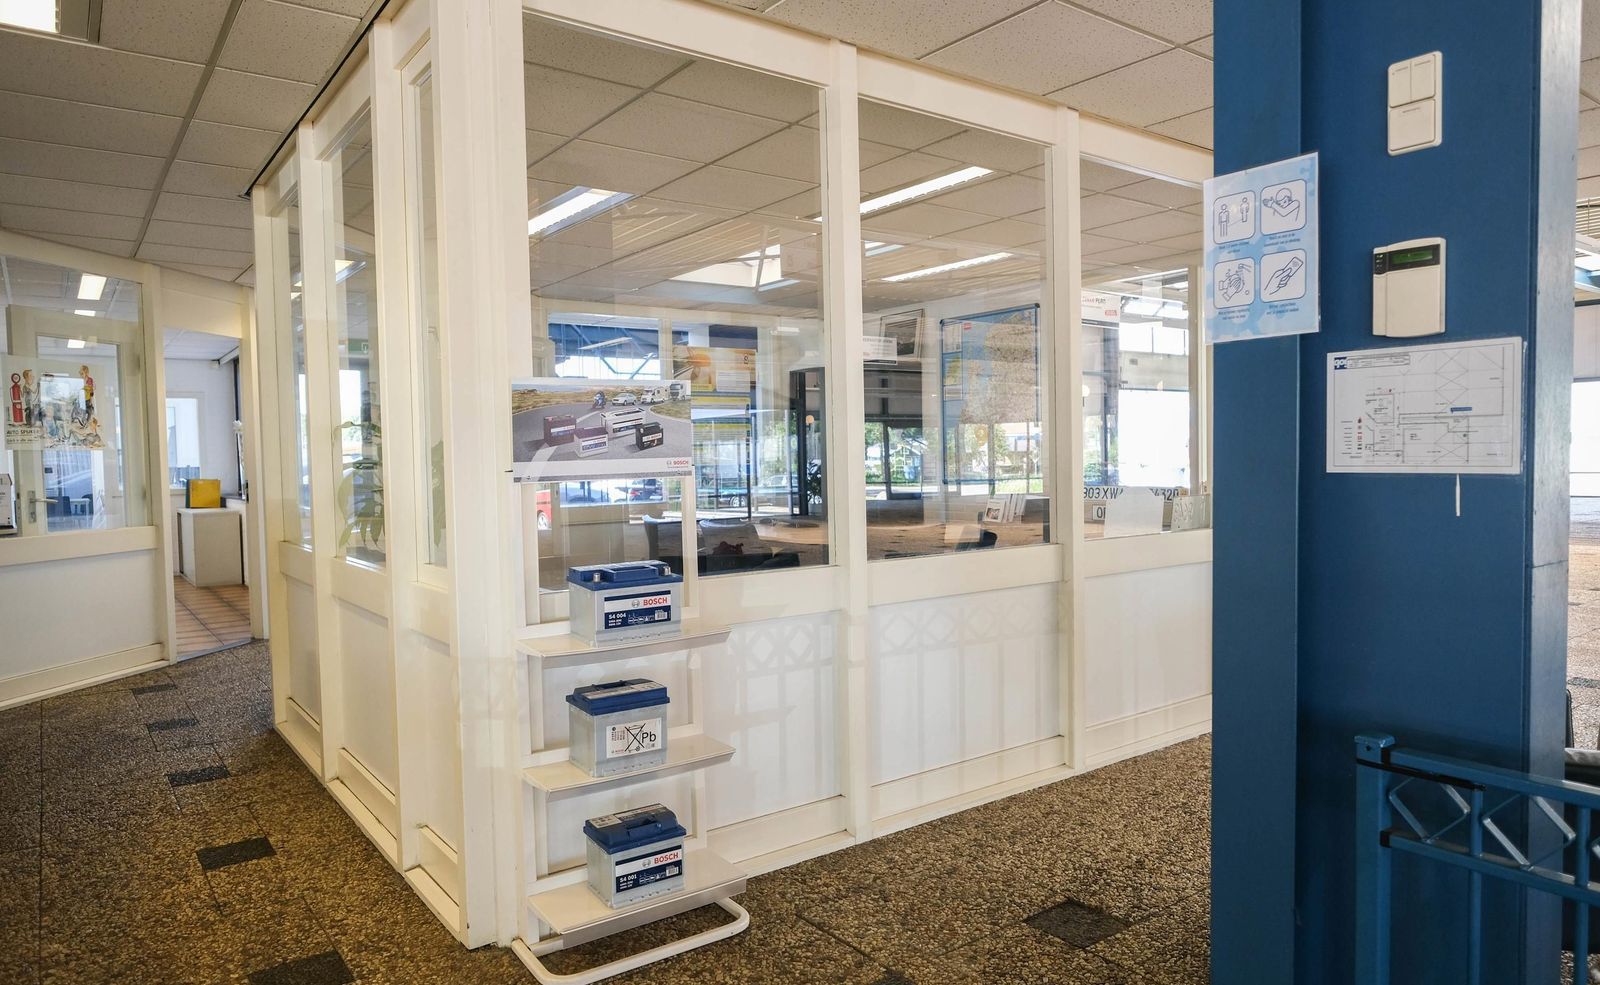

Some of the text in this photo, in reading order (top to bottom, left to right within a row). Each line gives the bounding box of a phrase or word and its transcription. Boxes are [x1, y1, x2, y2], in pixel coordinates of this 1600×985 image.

[643, 597, 668, 606] BOSCH
[641, 731, 657, 744] Pb
[654, 852, 679, 864] BOSCH
